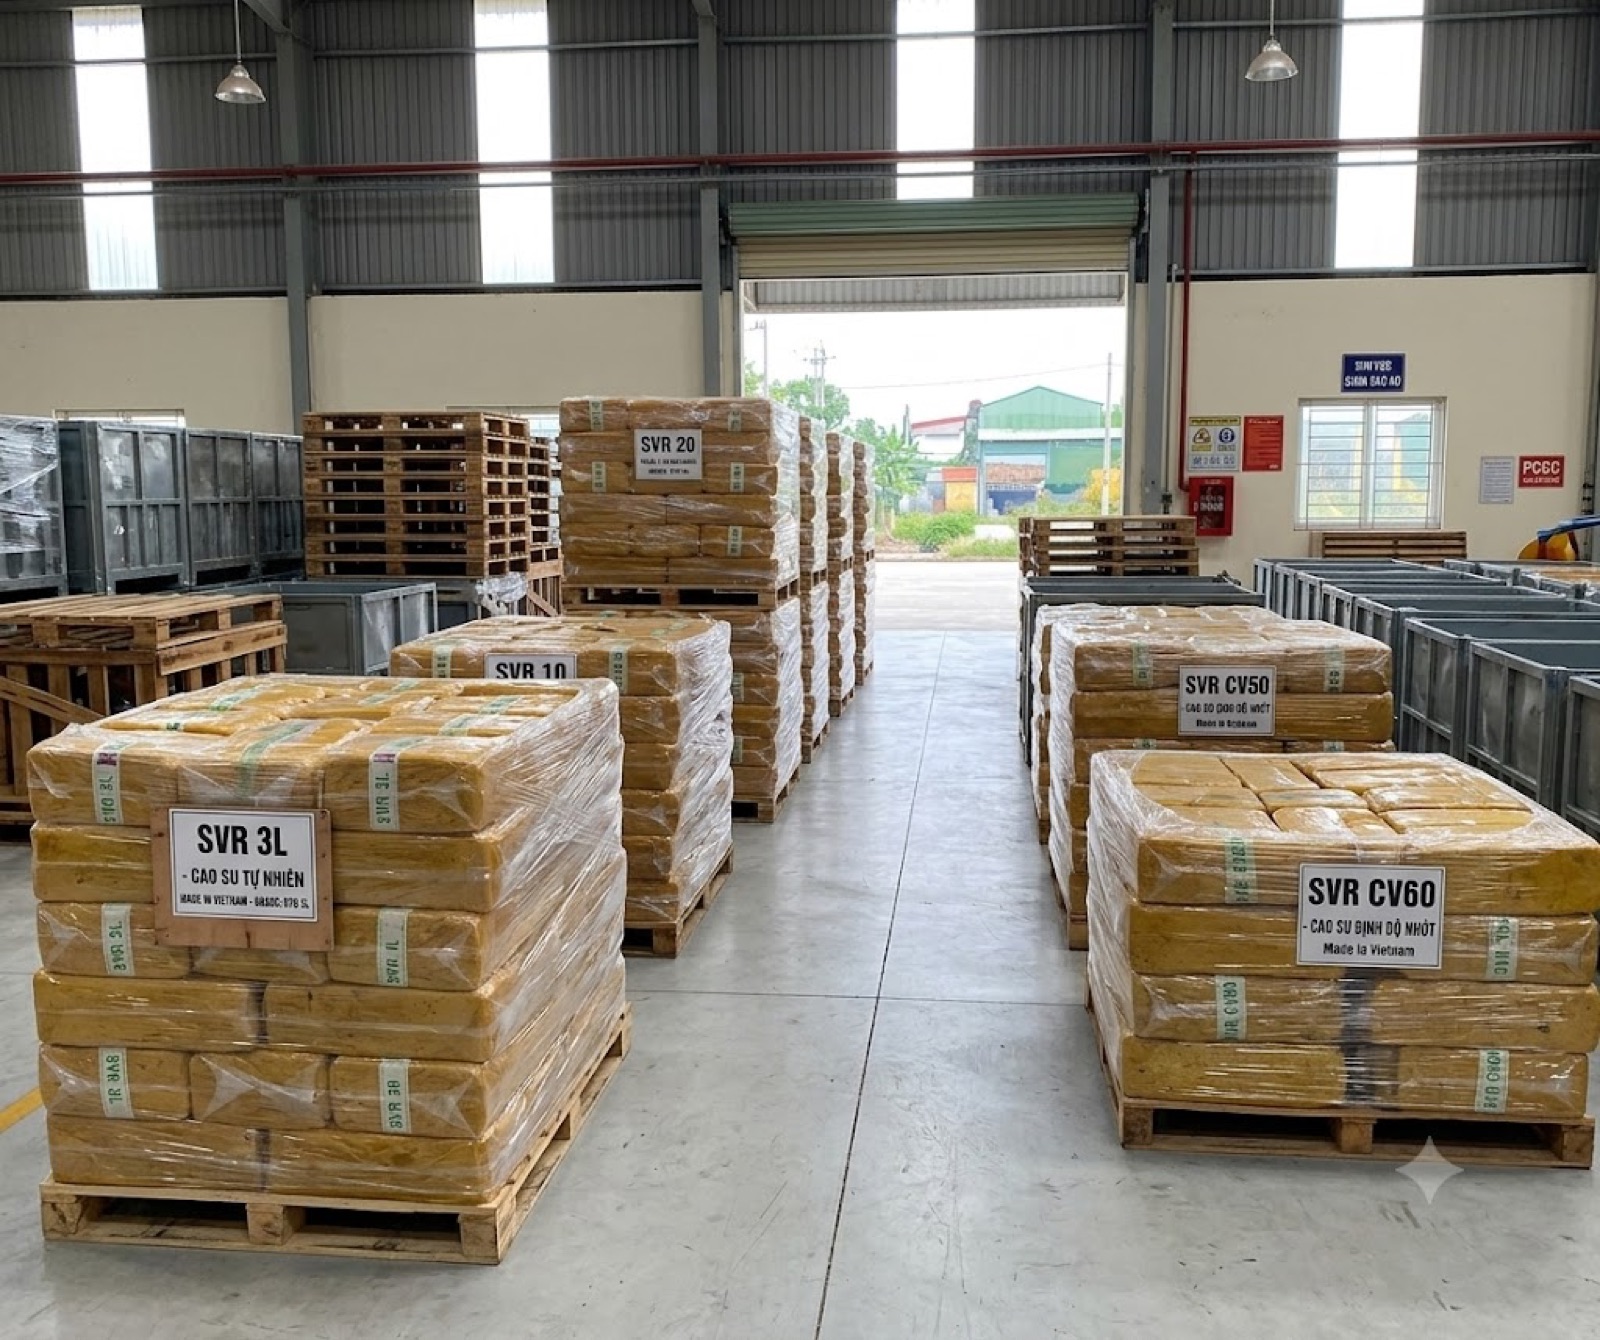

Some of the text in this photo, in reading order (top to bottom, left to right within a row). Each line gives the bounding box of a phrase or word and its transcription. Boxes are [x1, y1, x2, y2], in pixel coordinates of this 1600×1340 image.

[642, 436, 695, 453] SVR 20
[496, 662, 566, 679] SVR 10
[1186, 676, 1270, 694] SVR CV50
[198, 824, 288, 856] SVR 3L
[191, 868, 218, 885] CAO
[221, 869, 239, 886] SU
[1308, 878, 1436, 908] SVR CV60
[1310, 918, 1334, 934] CAO
[1336, 920, 1352, 934] SU
